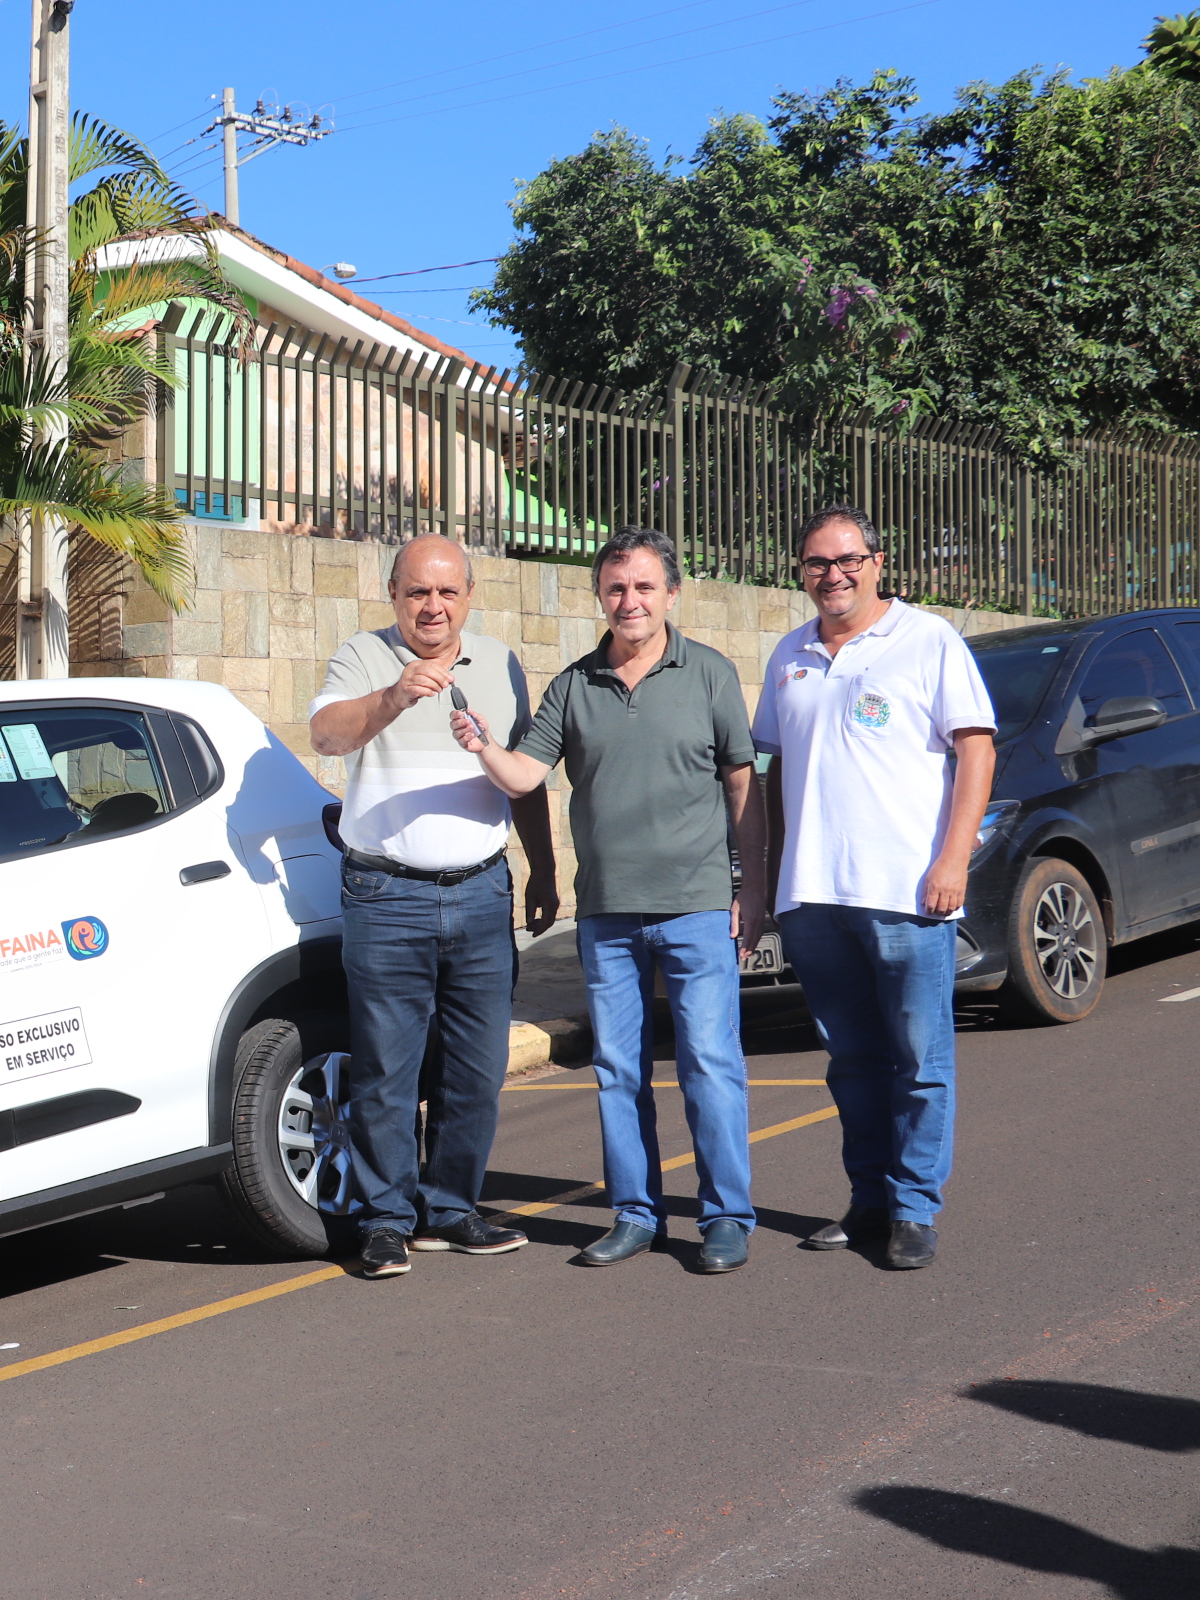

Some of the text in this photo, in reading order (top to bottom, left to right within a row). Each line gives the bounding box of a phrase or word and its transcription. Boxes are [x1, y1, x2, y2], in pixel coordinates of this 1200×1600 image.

[13, 956, 26, 964] que
[32, 950, 52, 962] gente
[17, 1018, 80, 1045] EXCLUSIVO
[5, 1042, 76, 1071] EM SERVIÇO
